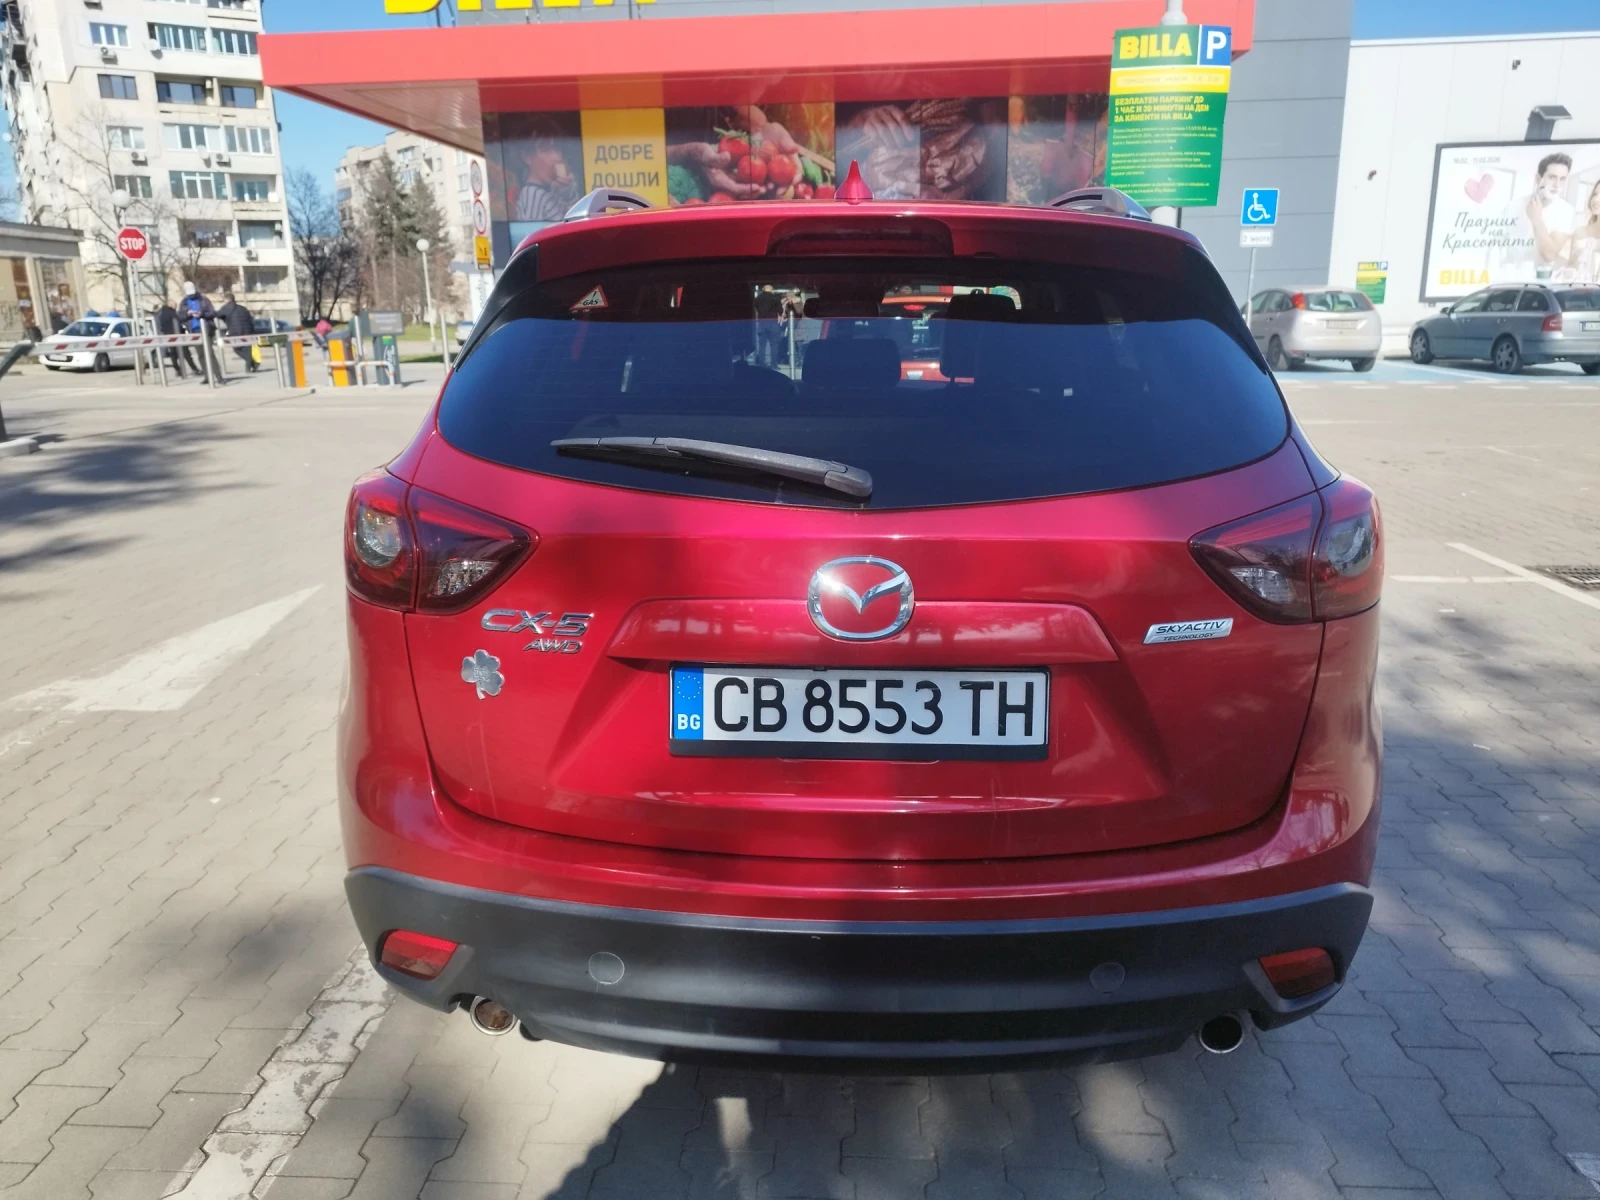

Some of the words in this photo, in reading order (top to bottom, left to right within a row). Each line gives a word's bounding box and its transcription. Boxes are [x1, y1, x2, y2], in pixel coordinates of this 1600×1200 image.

[1119, 32, 1192, 59] BILLA
[1206, 30, 1227, 59] P
[1115, 96, 1158, 106] БЕЗПЛАТЕН
[1160, 95, 1193, 104] ПАРКИНГ
[1194, 95, 1204, 105] ДО
[1120, 105, 1135, 113] ЧАС
[1184, 103, 1194, 111] НА
[1194, 103, 1209, 112] ДЕН
[1114, 115, 1124, 123] ЗА
[1125, 113, 1160, 122] КЛИЕНТИ
[1172, 112, 1193, 120] BILLA
[594, 144, 654, 164] ДОБРЕ
[591, 171, 660, 191] ДОШЛИ
[1454, 212, 1519, 234] Празник
[1488, 229, 1504, 237] на
[120, 237, 145, 250] STOP
[1442, 233, 1535, 254] Красотата
[1439, 269, 1490, 285] BILLA
[582, 298, 599, 306] GAS
[481, 608, 595, 636] CX-5
[1156, 620, 1226, 634] SKYACTIV
[1163, 632, 1215, 641] TECHNOLOGY
[522, 638, 583, 654] AWD
[713, 677, 788, 733] CB
[802, 678, 944, 736] 8553
[959, 680, 1035, 737] TH
[676, 713, 701, 730] BG
